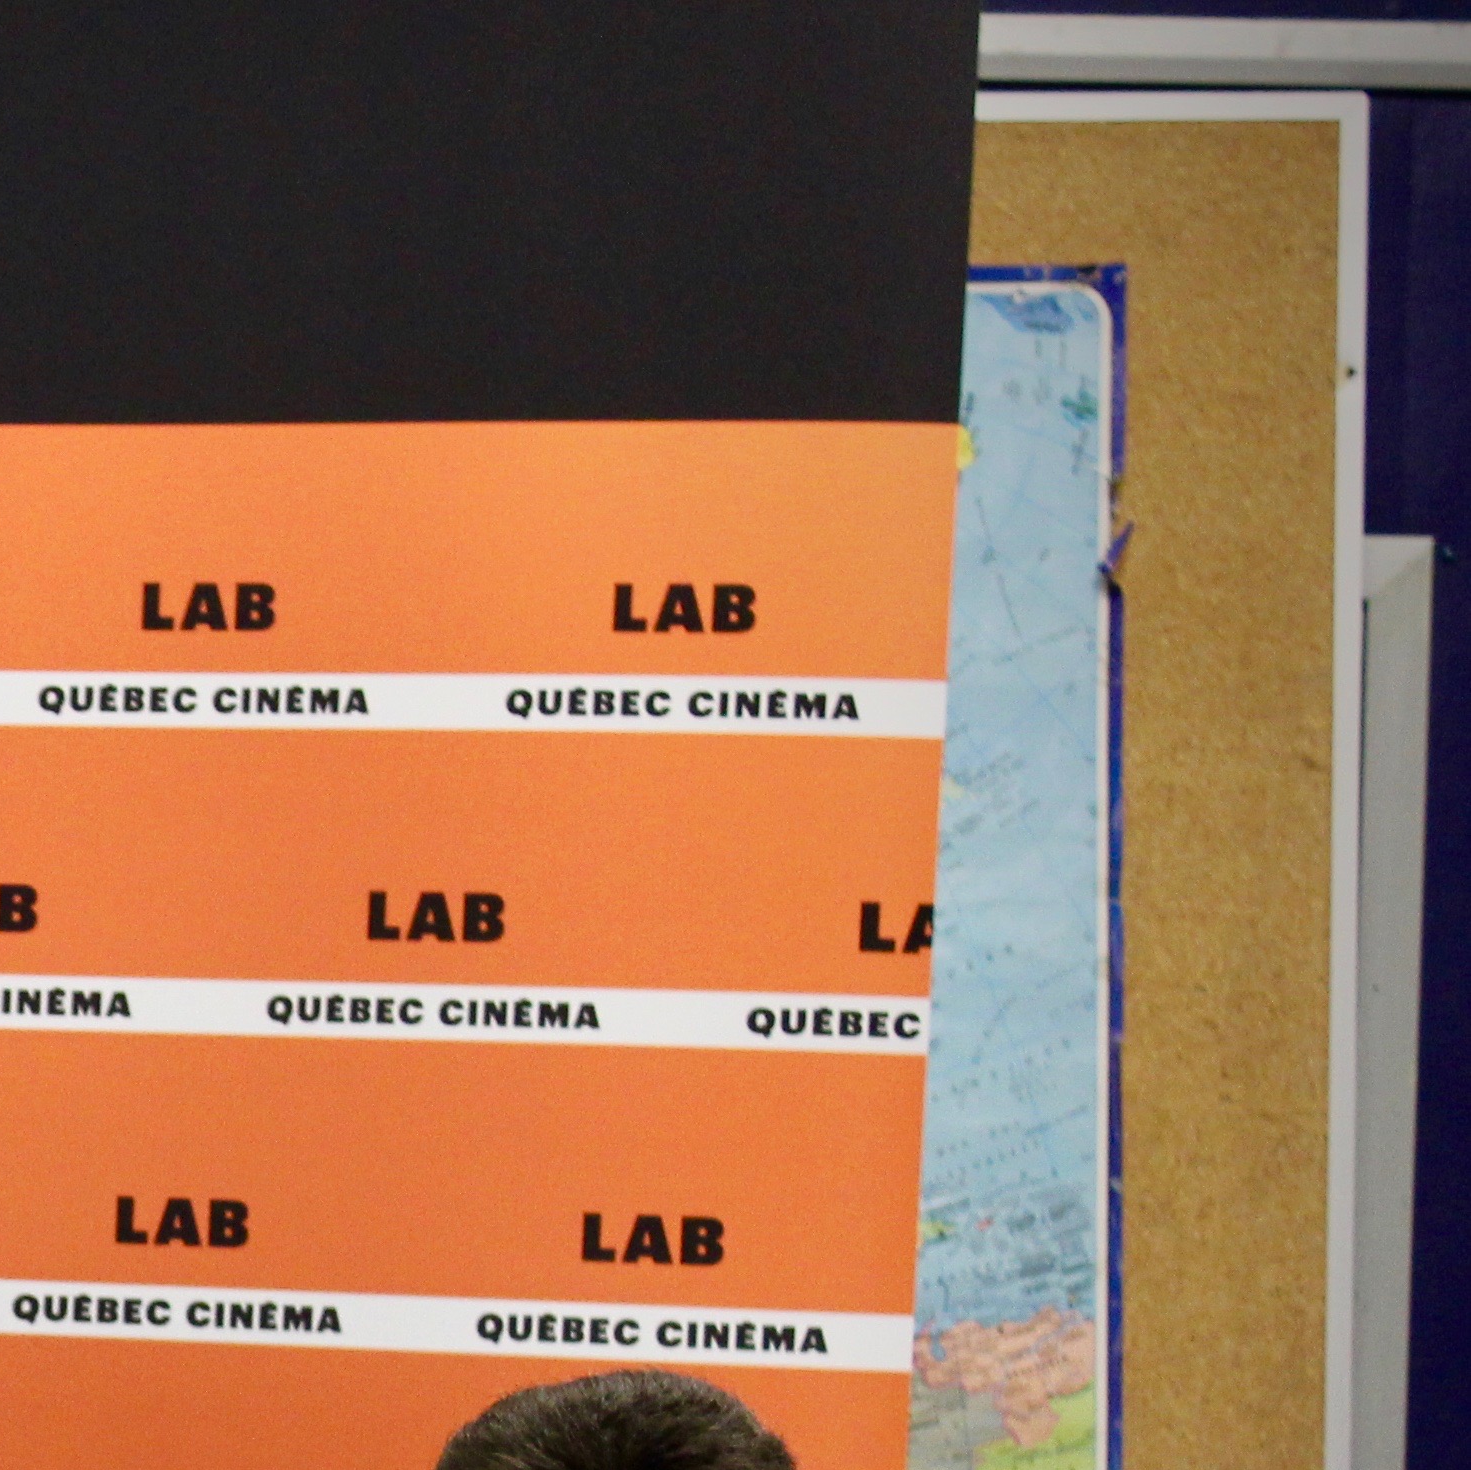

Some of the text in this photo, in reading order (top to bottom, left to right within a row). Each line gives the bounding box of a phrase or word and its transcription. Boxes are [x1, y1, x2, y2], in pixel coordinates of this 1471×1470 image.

[142, 582, 276, 631] LAB
[613, 584, 757, 633] LAB
[38, 682, 370, 715] QUÉBEC CINÉMA
[506, 686, 860, 721] QUÉBEC CINÉMA
[367, 891, 505, 943] LAB
[267, 993, 601, 1030] QUÉBEC CINÉMA
[746, 1006, 921, 1040] QUÉBEC
[115, 1196, 249, 1248] LAB
[581, 1213, 725, 1266] LAB
[12, 1293, 343, 1334] QUÉBEC CINÉMA
[476, 1312, 829, 1355] QUÉBEC CINÉMA
